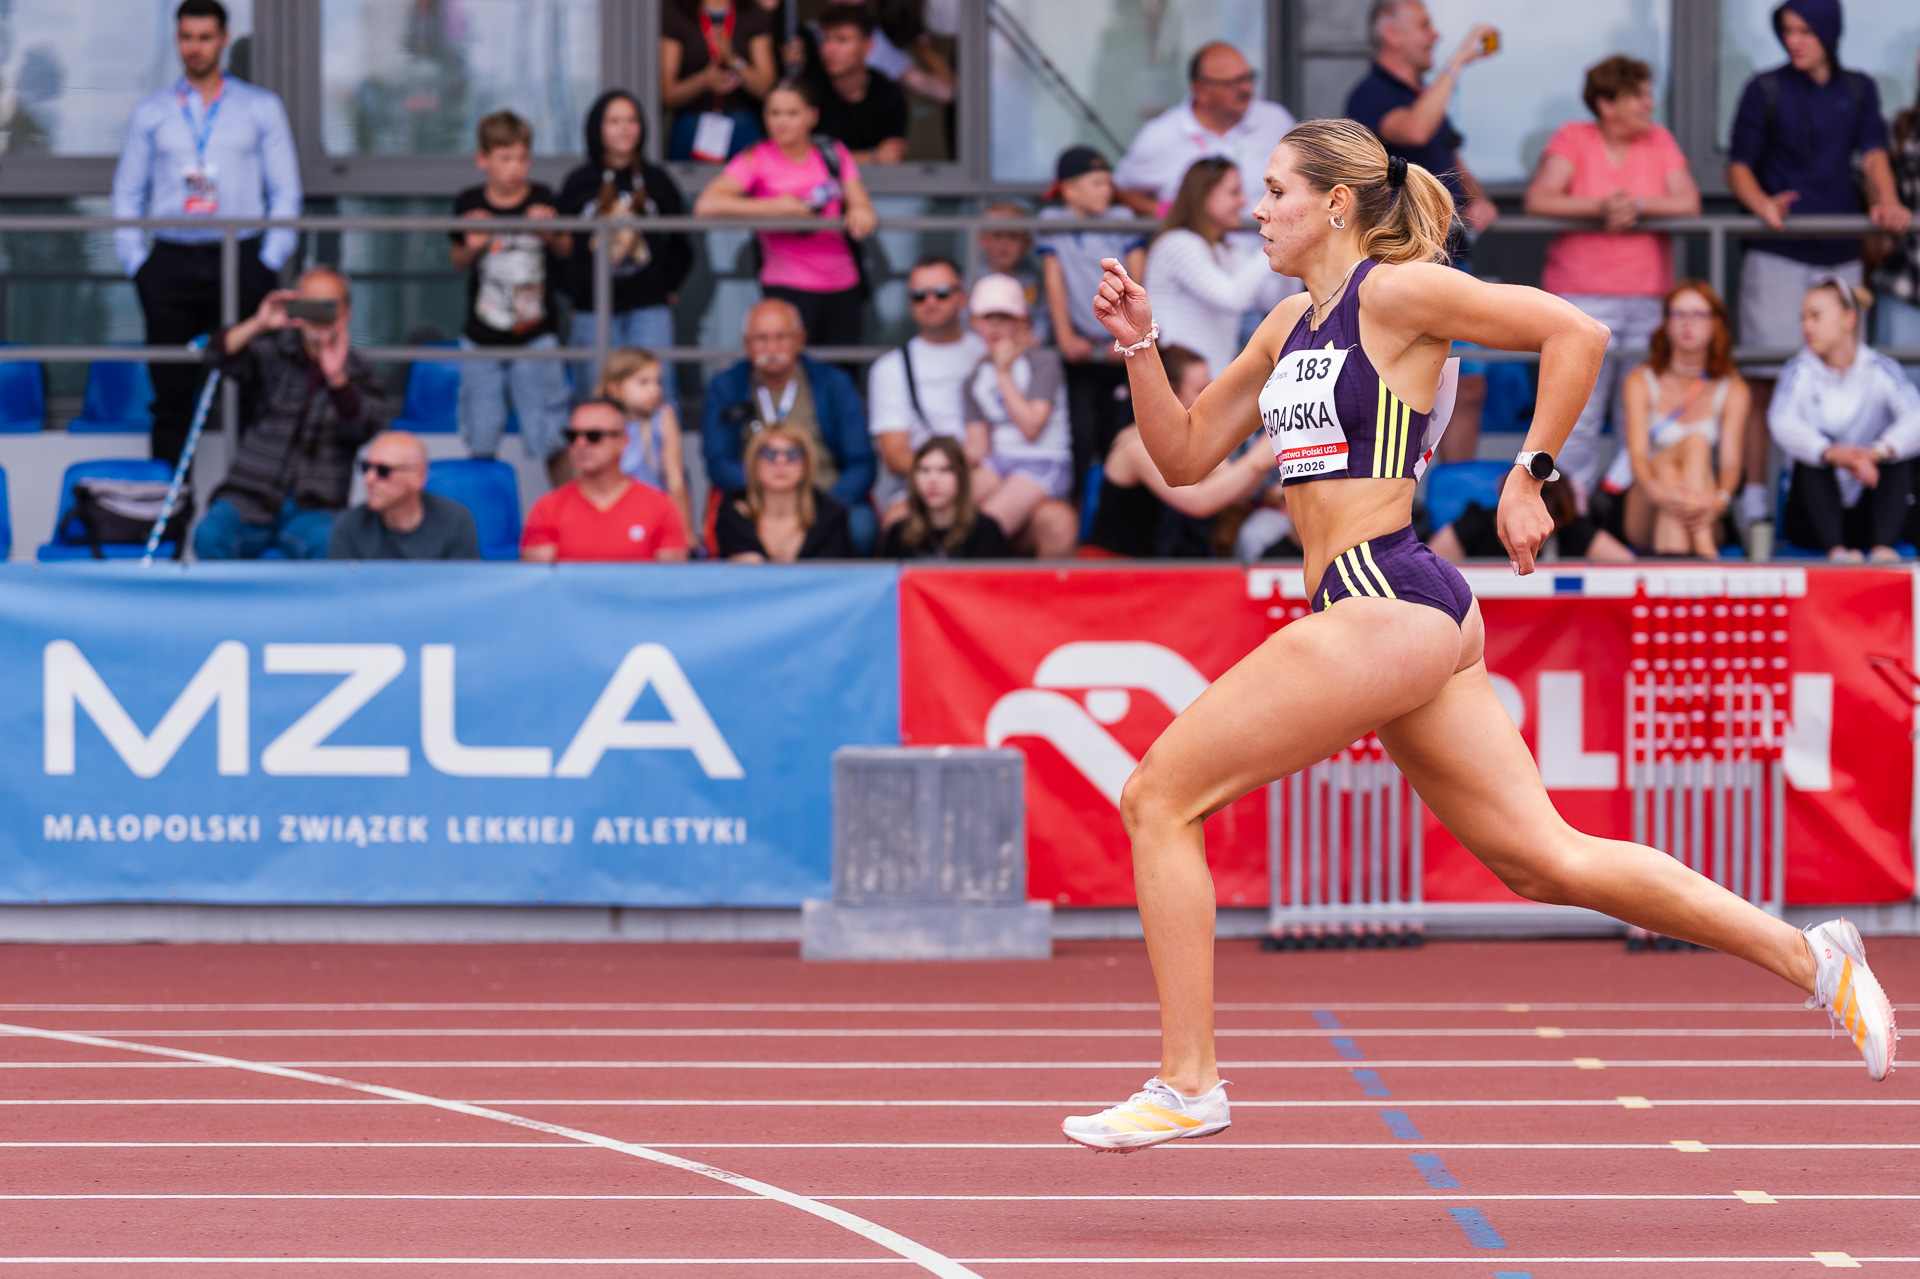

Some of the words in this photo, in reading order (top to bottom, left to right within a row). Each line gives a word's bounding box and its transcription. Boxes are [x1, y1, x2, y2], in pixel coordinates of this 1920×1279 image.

[1296, 357, 1332, 382] 183
[1301, 447, 1323, 457] Polski
[1323, 445, 1338, 454] U23
[1297, 460, 1325, 473] 2026
[43, 638, 746, 780] MZLA
[43, 813, 261, 843] MAŁOPOLSKI
[278, 814, 429, 849] ZWIĄZEK
[446, 815, 575, 845] LEKKIEJ
[591, 816, 747, 845] ATLETYKI
